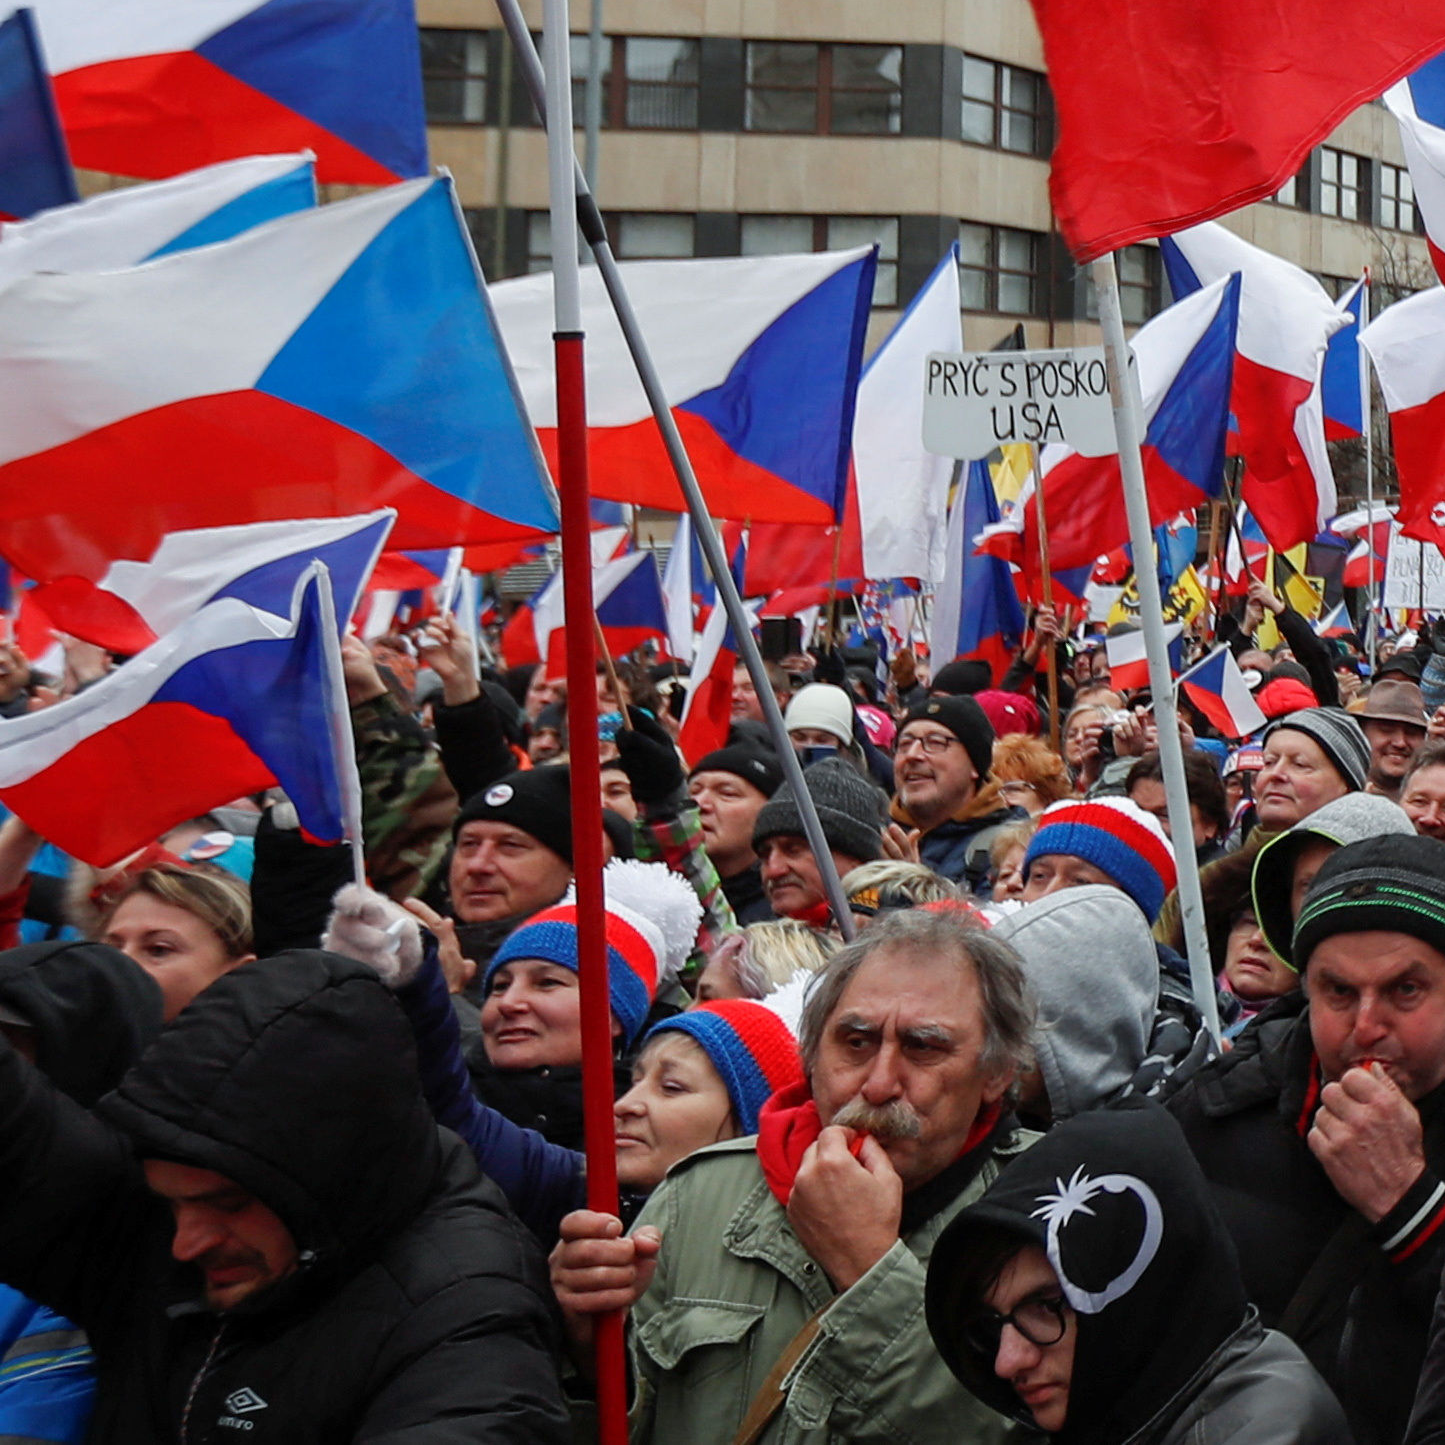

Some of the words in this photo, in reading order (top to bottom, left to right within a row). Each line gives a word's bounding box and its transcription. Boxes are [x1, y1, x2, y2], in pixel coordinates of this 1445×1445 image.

[927, 357, 990, 397] PRYČ
[999, 361, 1018, 398] S
[990, 402, 1066, 441] USA
